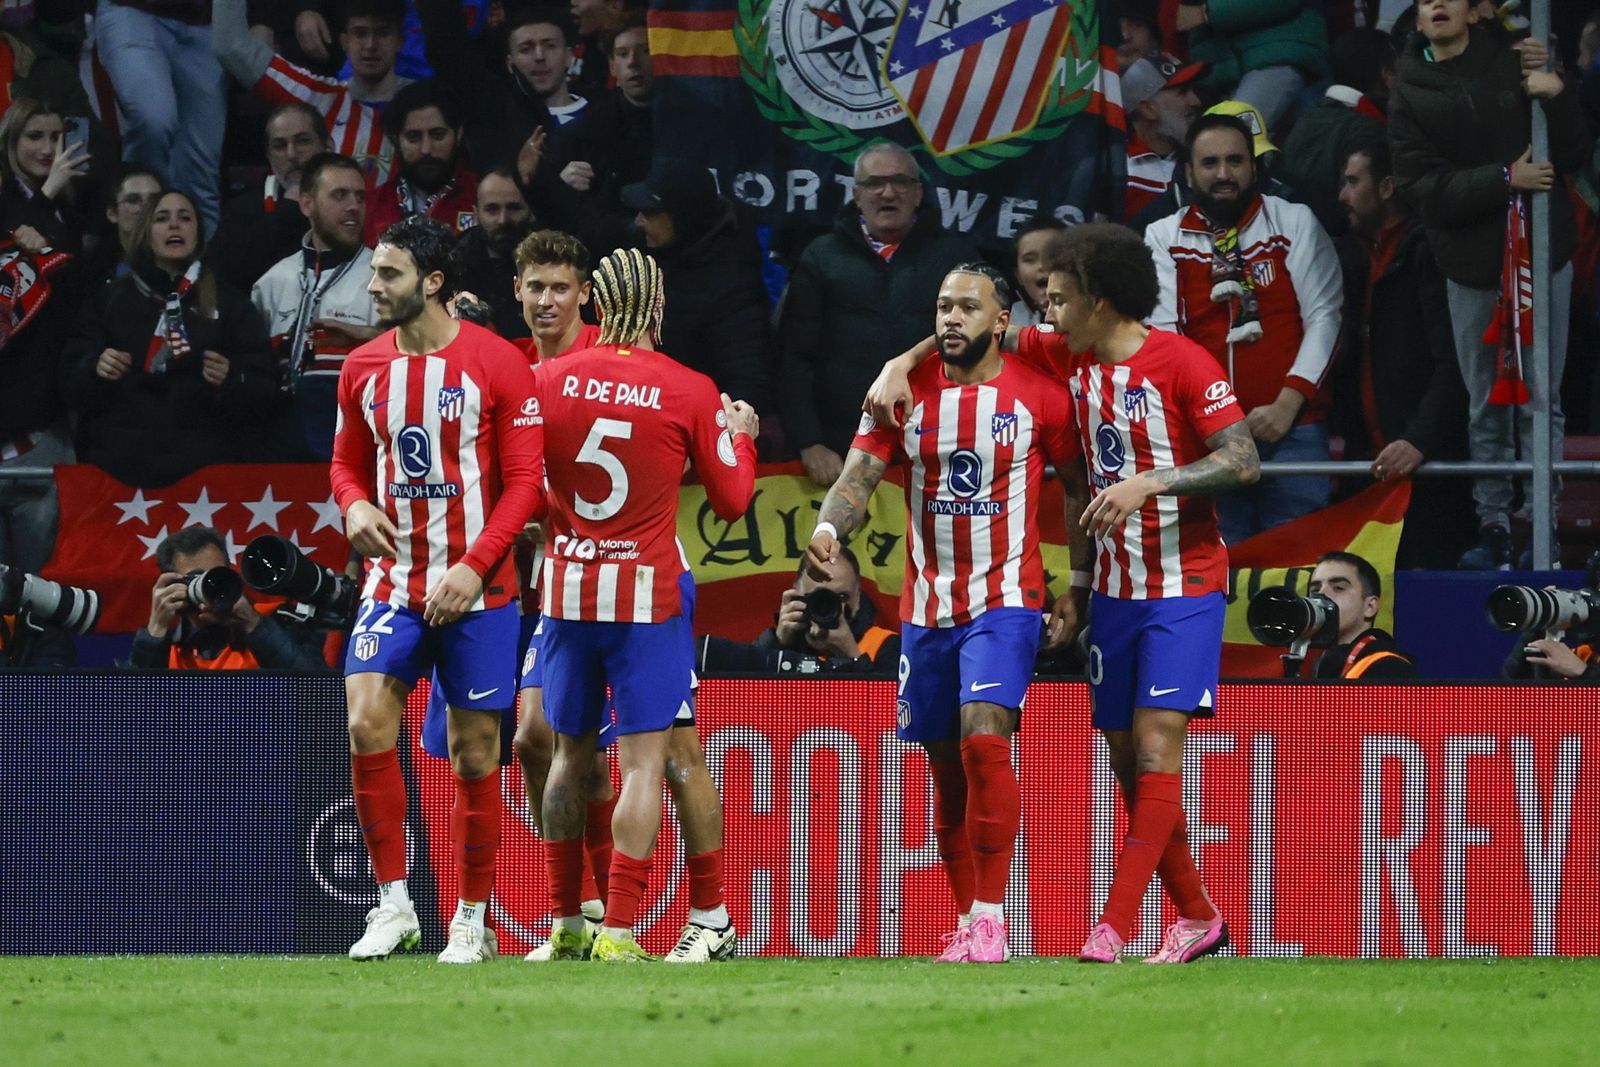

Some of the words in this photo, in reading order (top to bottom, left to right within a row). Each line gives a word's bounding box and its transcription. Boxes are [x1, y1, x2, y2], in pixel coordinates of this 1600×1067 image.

[562, 375, 580, 398] R.
[584, 378, 613, 403] DE
[614, 382, 662, 410] PAUL
[574, 417, 633, 521] 5
[388, 484, 430, 497] RIYADH
[433, 484, 458, 496] AIR
[927, 500, 974, 514] RIYADH
[977, 501, 1000, 514] AIR
[554, 528, 597, 560] ria
[598, 550, 640, 560] Transfer
[599, 539, 638, 550] Money
[351, 598, 399, 636] 22
[1361, 732, 1583, 959] REY
